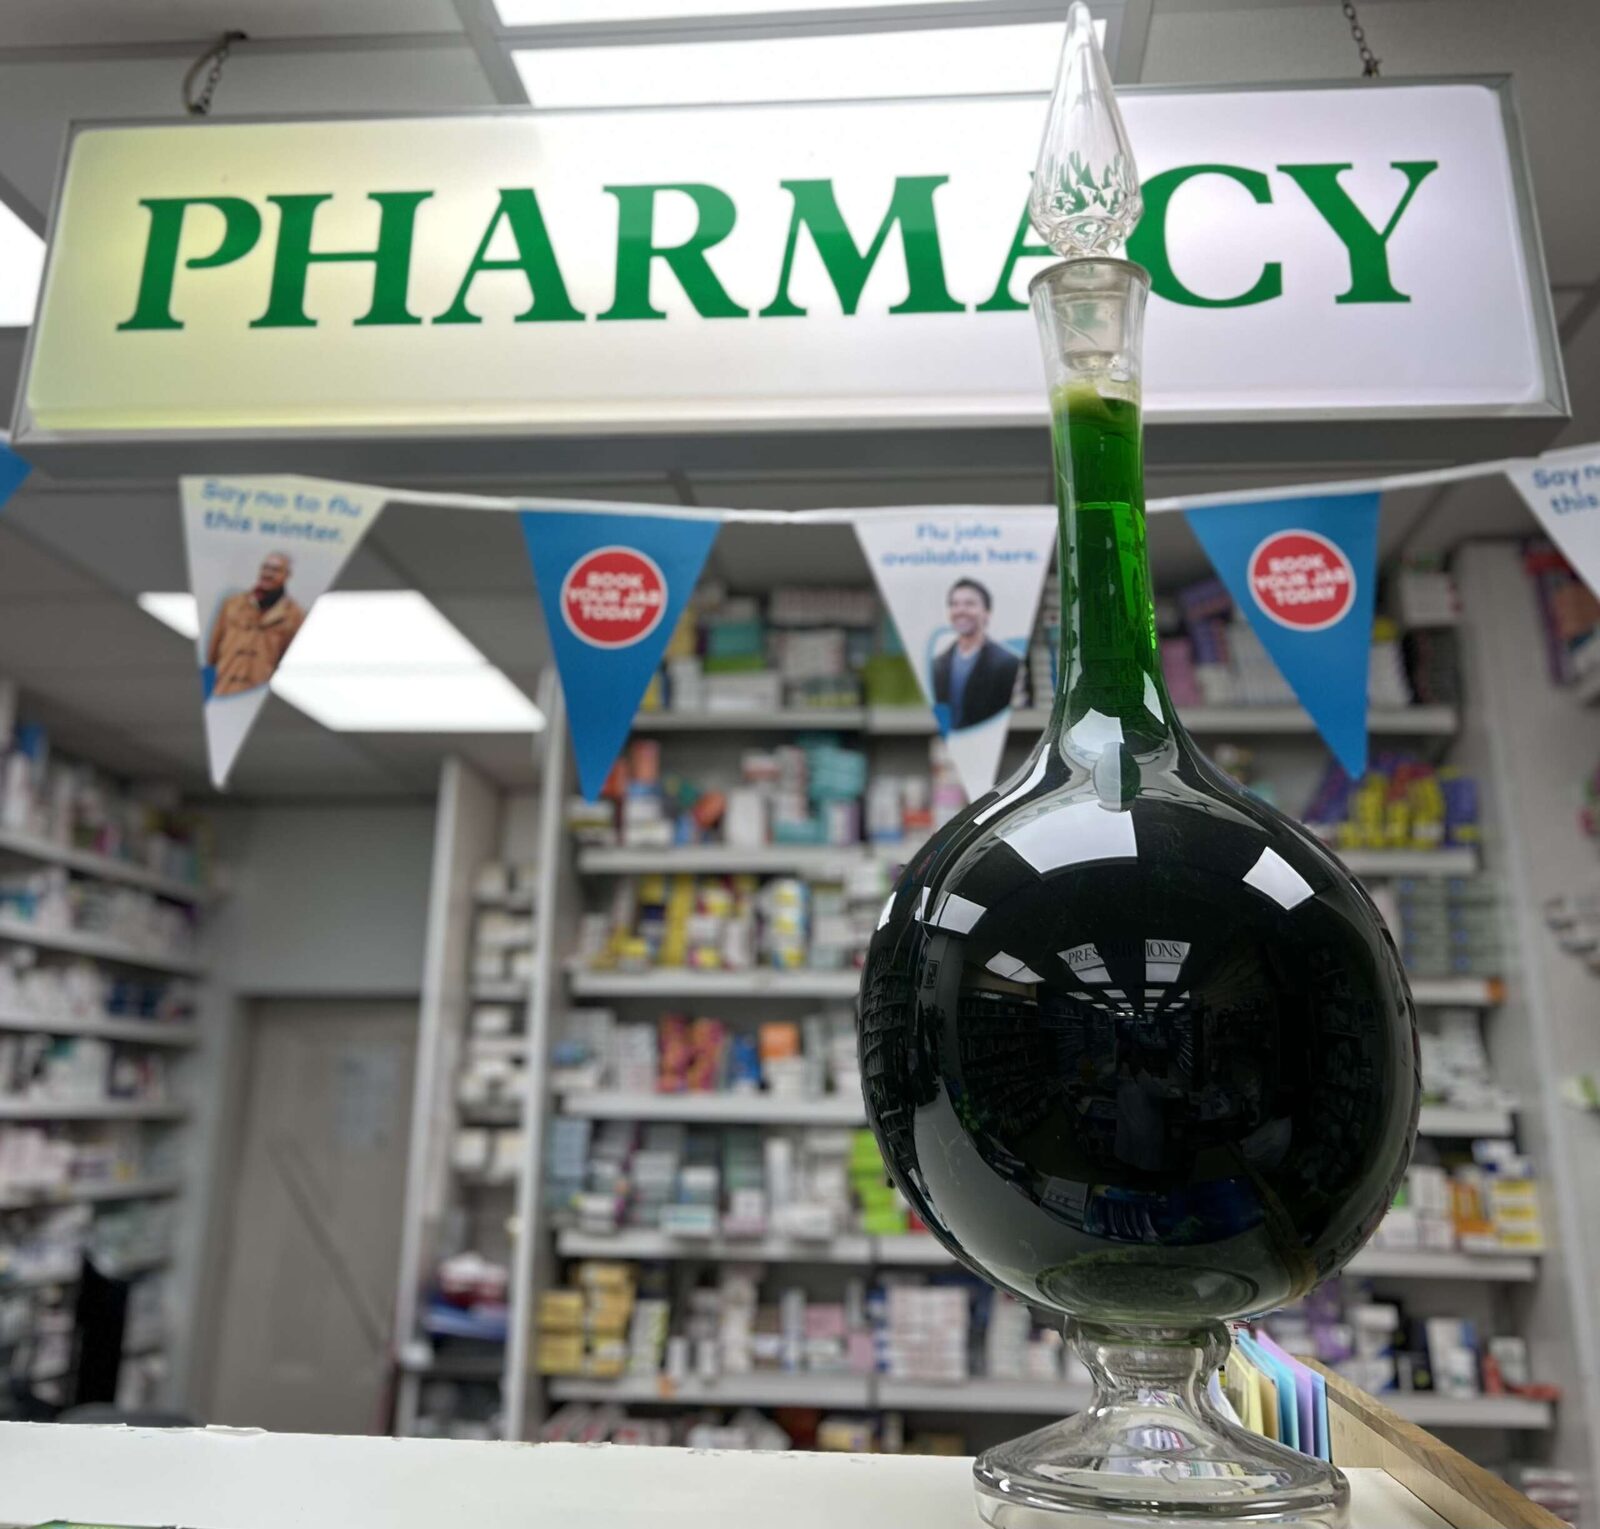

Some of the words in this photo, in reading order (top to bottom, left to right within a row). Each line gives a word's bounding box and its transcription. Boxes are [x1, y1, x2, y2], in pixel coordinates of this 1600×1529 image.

[1532, 467, 1580, 493] Say
[202, 479, 251, 511] Say
[255, 488, 287, 508] no
[294, 490, 321, 512] to
[328, 494, 362, 518] flu
[1551, 493, 1599, 517] this
[204, 509, 252, 532] this
[916, 523, 949, 540] Flu
[954, 523, 1001, 544] jabs
[881, 549, 981, 566] available
[1268, 553, 1326, 574] BOOK
[586, 571, 645, 588] BOOK
[1255, 572, 1308, 592] YOUR
[1310, 565, 1349, 588] JAB
[568, 586, 621, 605] YOUR
[623, 589, 661, 607] JAB
[1273, 586, 1337, 607] TODAY
[581, 604, 646, 622] TODAY
[1067, 940, 1182, 965] PRESRIPIONS
